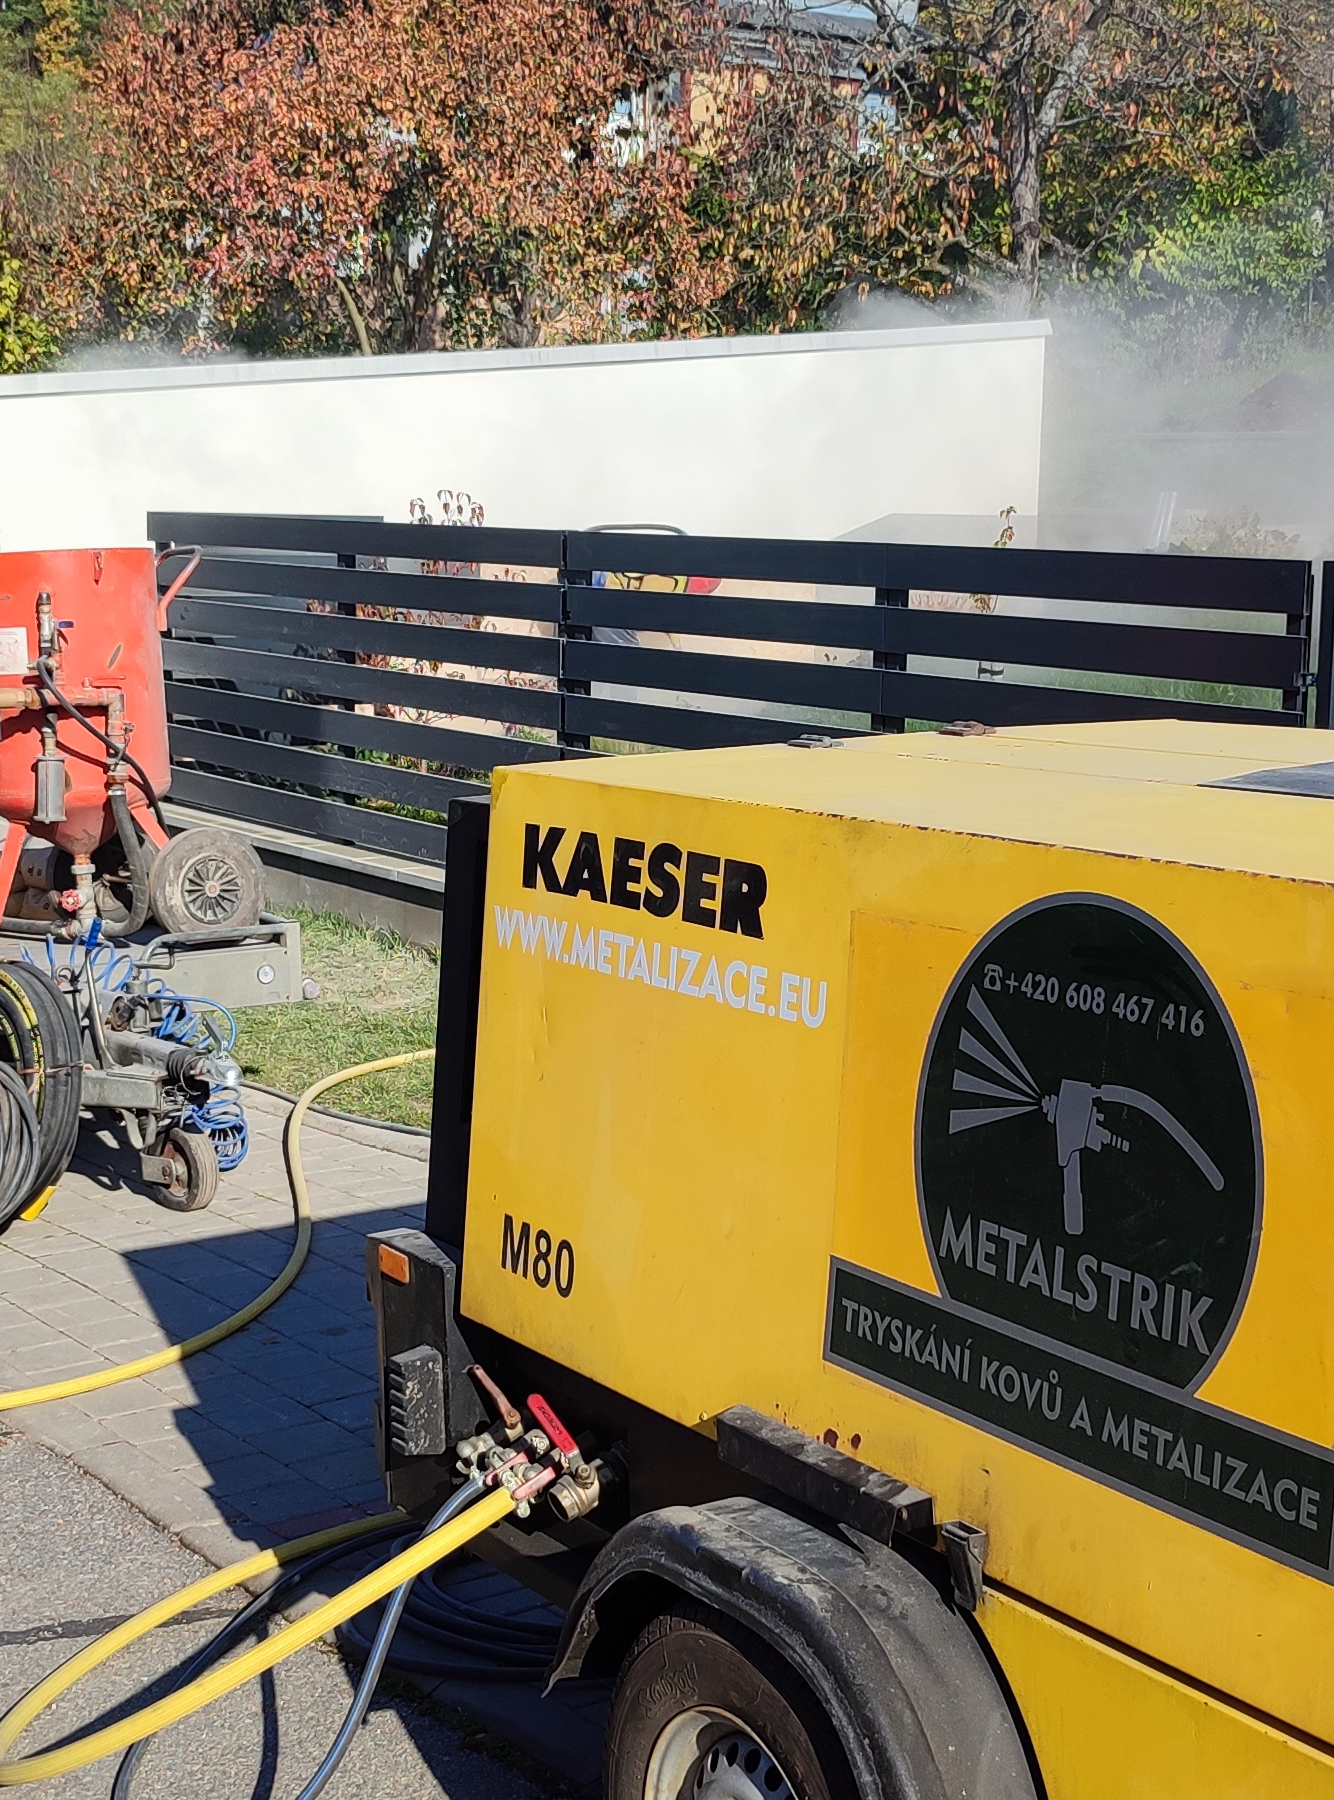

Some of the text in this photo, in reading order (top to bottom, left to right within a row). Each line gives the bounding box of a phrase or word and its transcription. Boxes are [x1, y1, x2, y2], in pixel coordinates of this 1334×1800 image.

[522, 822, 768, 940] KAESER
[493, 904, 828, 1029] WWW.METALIZACE.EU
[1004, 971, 1206, 1037] +420 608 467 416
[500, 1212, 575, 1298] M80
[938, 1205, 1214, 1356] METALSTRIK
[840, 1296, 1322, 1531] TRYSKÁNÍ KOVŮ A METALIZACE
